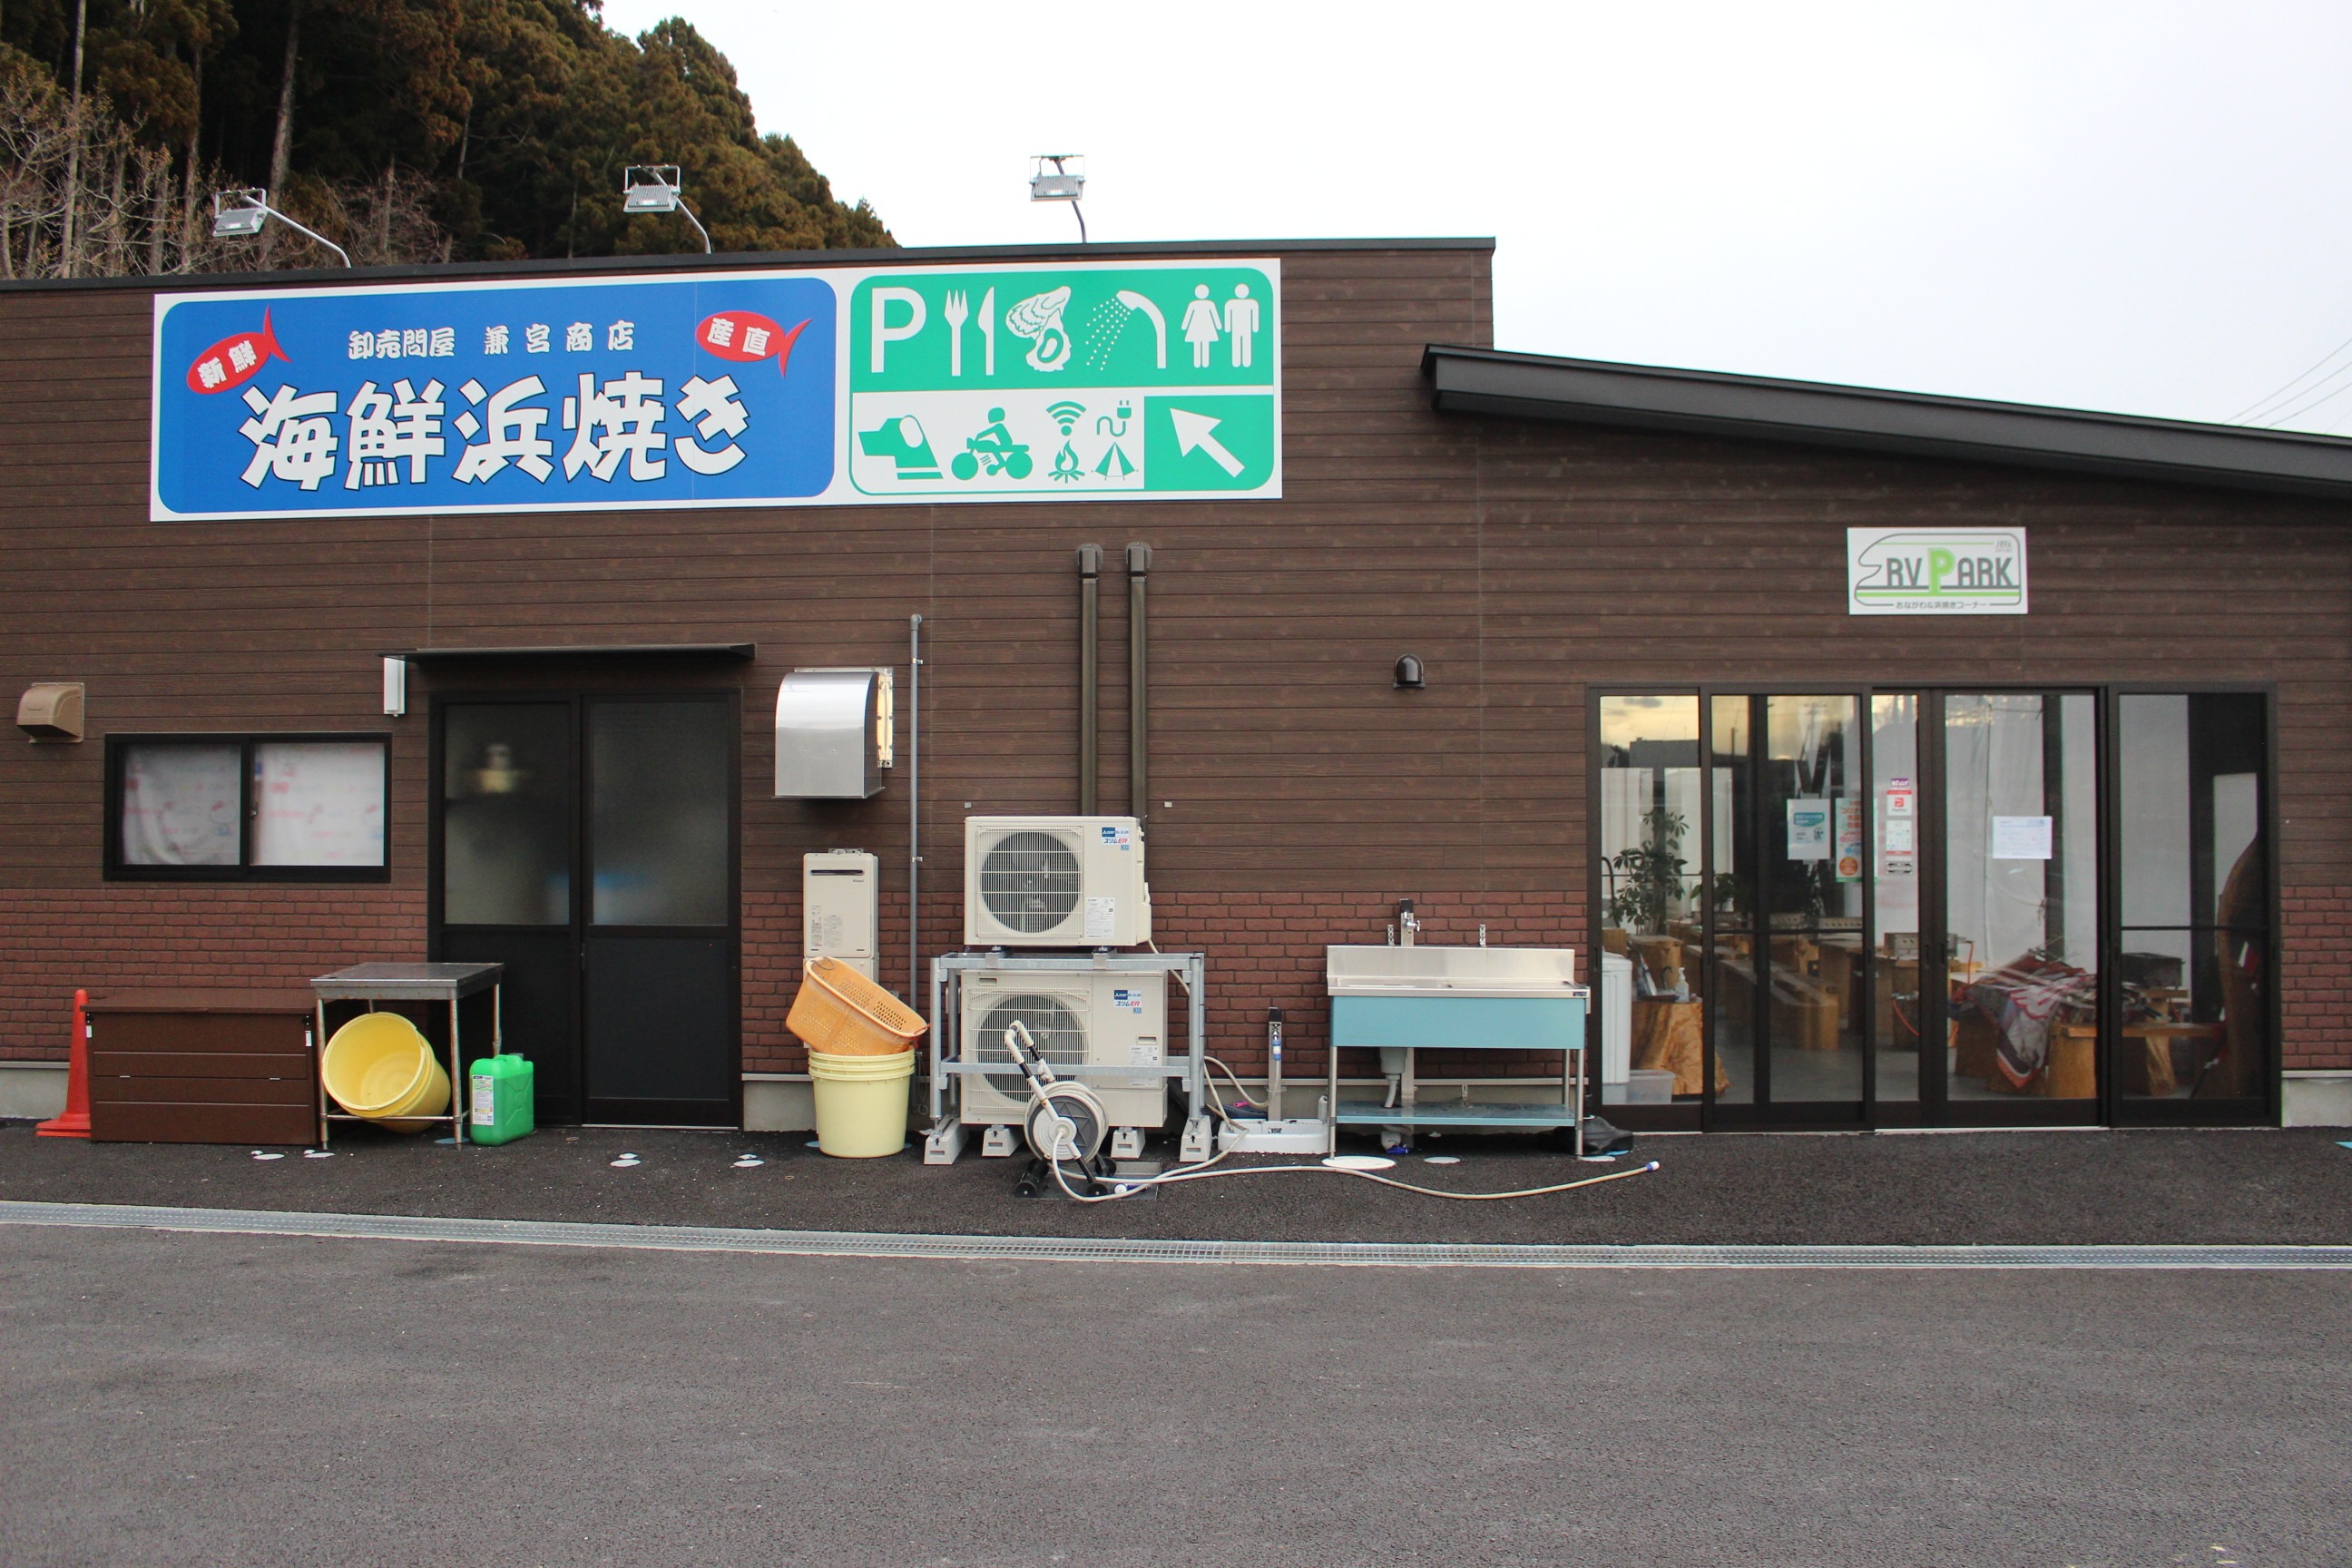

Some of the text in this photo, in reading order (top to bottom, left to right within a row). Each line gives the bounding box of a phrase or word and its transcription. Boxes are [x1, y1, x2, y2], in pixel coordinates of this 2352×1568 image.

[348, 319, 636, 361] 卸売問屋 兼宮商店
[707, 317, 770, 357] 産直
[871, 287, 927, 373] P
[197, 339, 258, 389] 新鮮
[235, 369, 751, 493] 海鮮浜焼き
[1886, 546, 2014, 594] RV PARK
